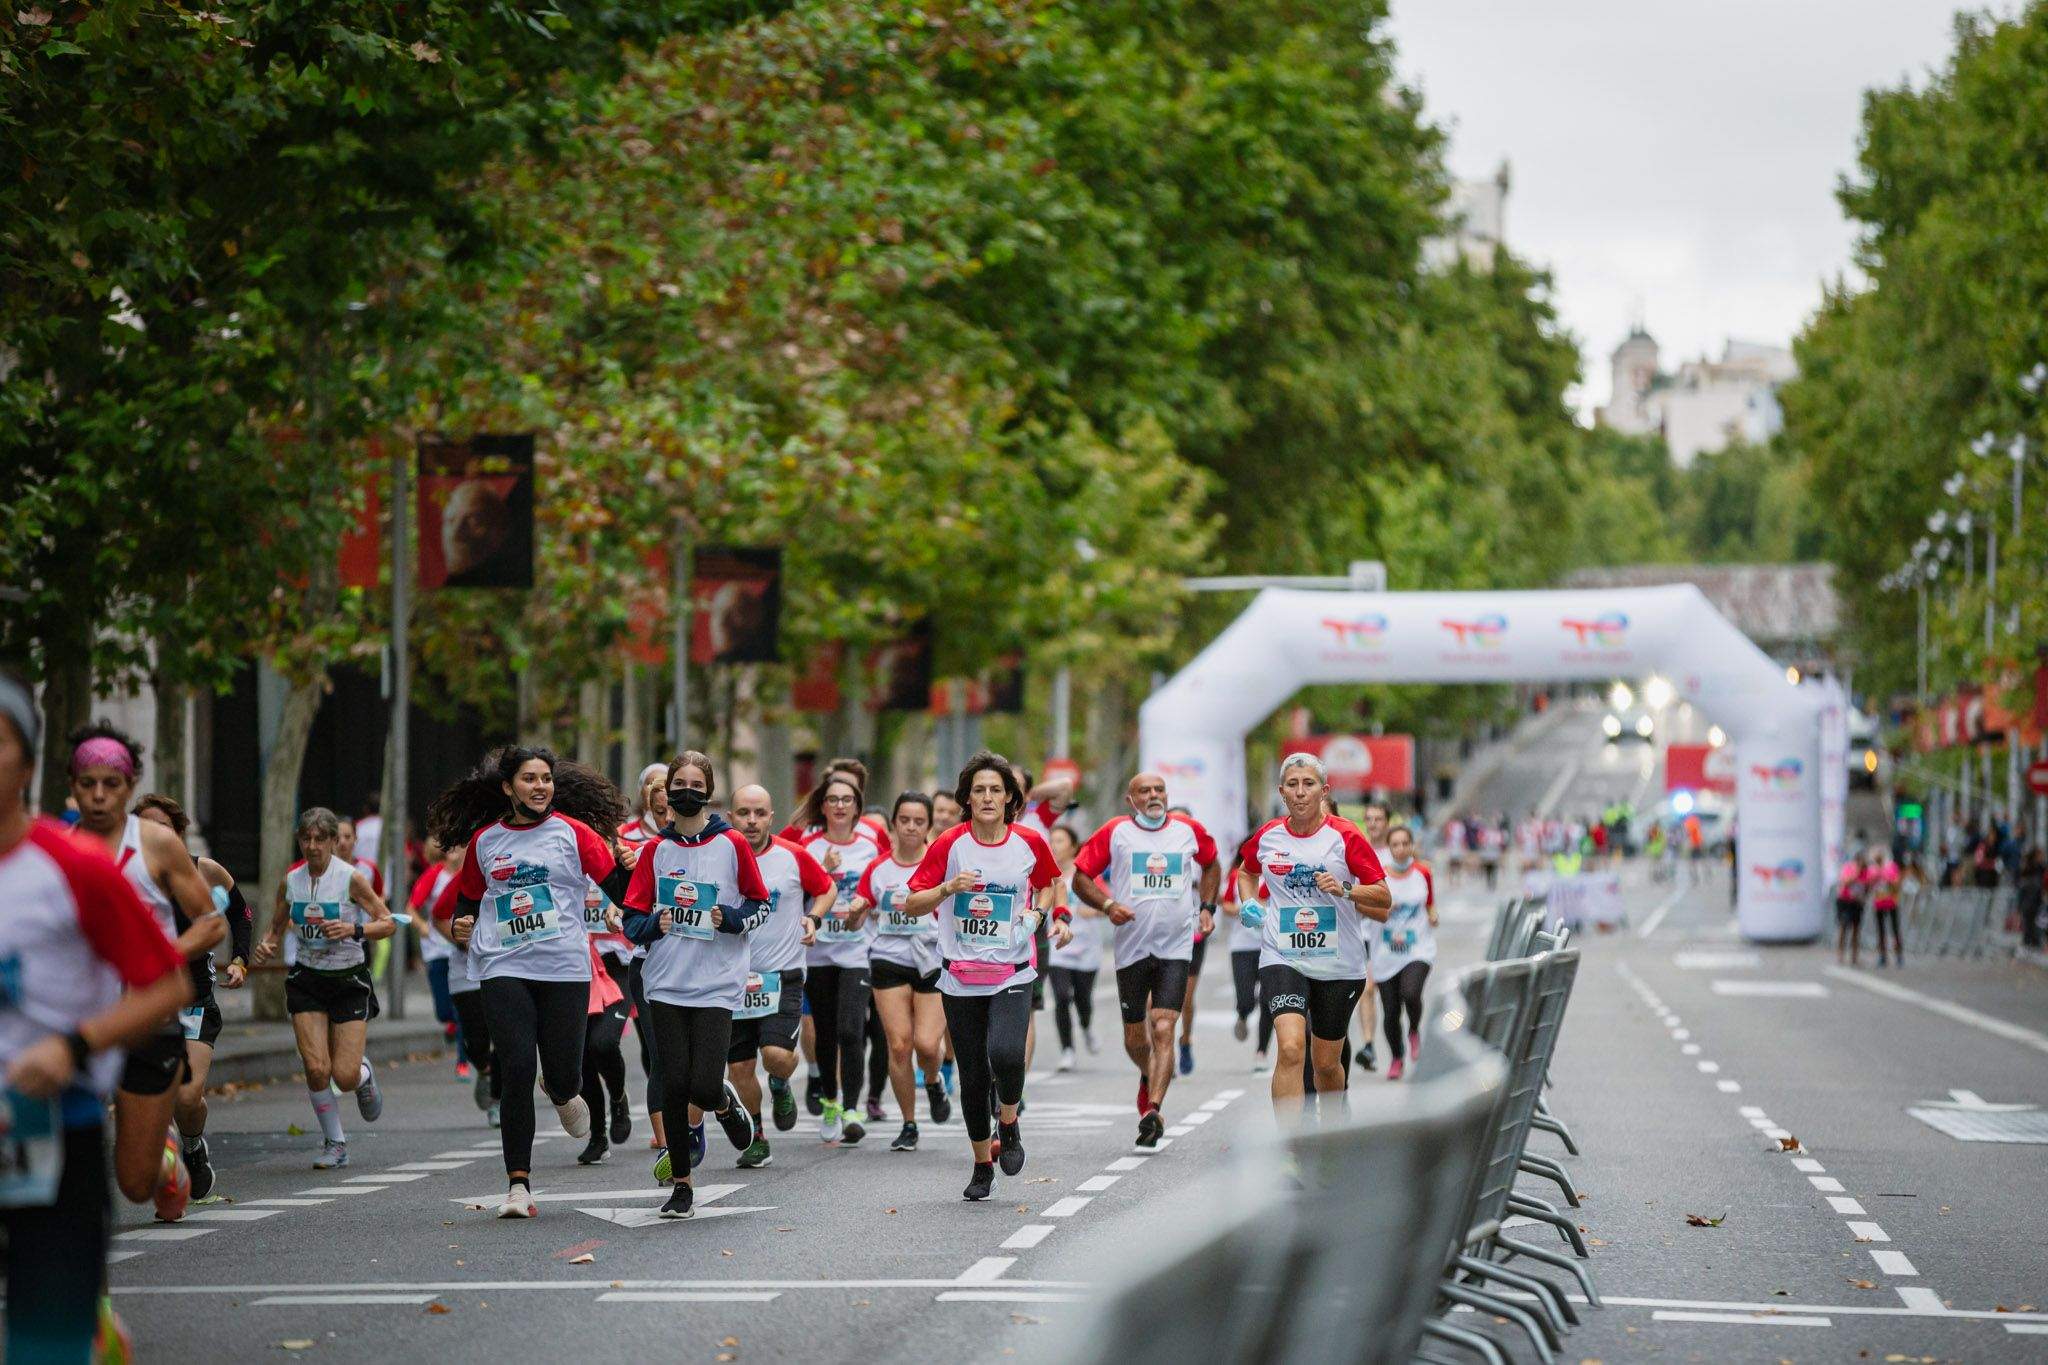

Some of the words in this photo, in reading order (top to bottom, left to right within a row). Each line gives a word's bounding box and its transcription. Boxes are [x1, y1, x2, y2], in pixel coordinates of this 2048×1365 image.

[1143, 875, 1171, 888] 1075
[508, 913, 546, 935] 1044
[669, 907, 702, 926] 1047
[301, 925, 321, 939] 102
[827, 920, 848, 933] 104
[962, 919, 999, 936] 1032
[1289, 932, 1327, 949] 1062
[744, 993, 770, 1008] 055
